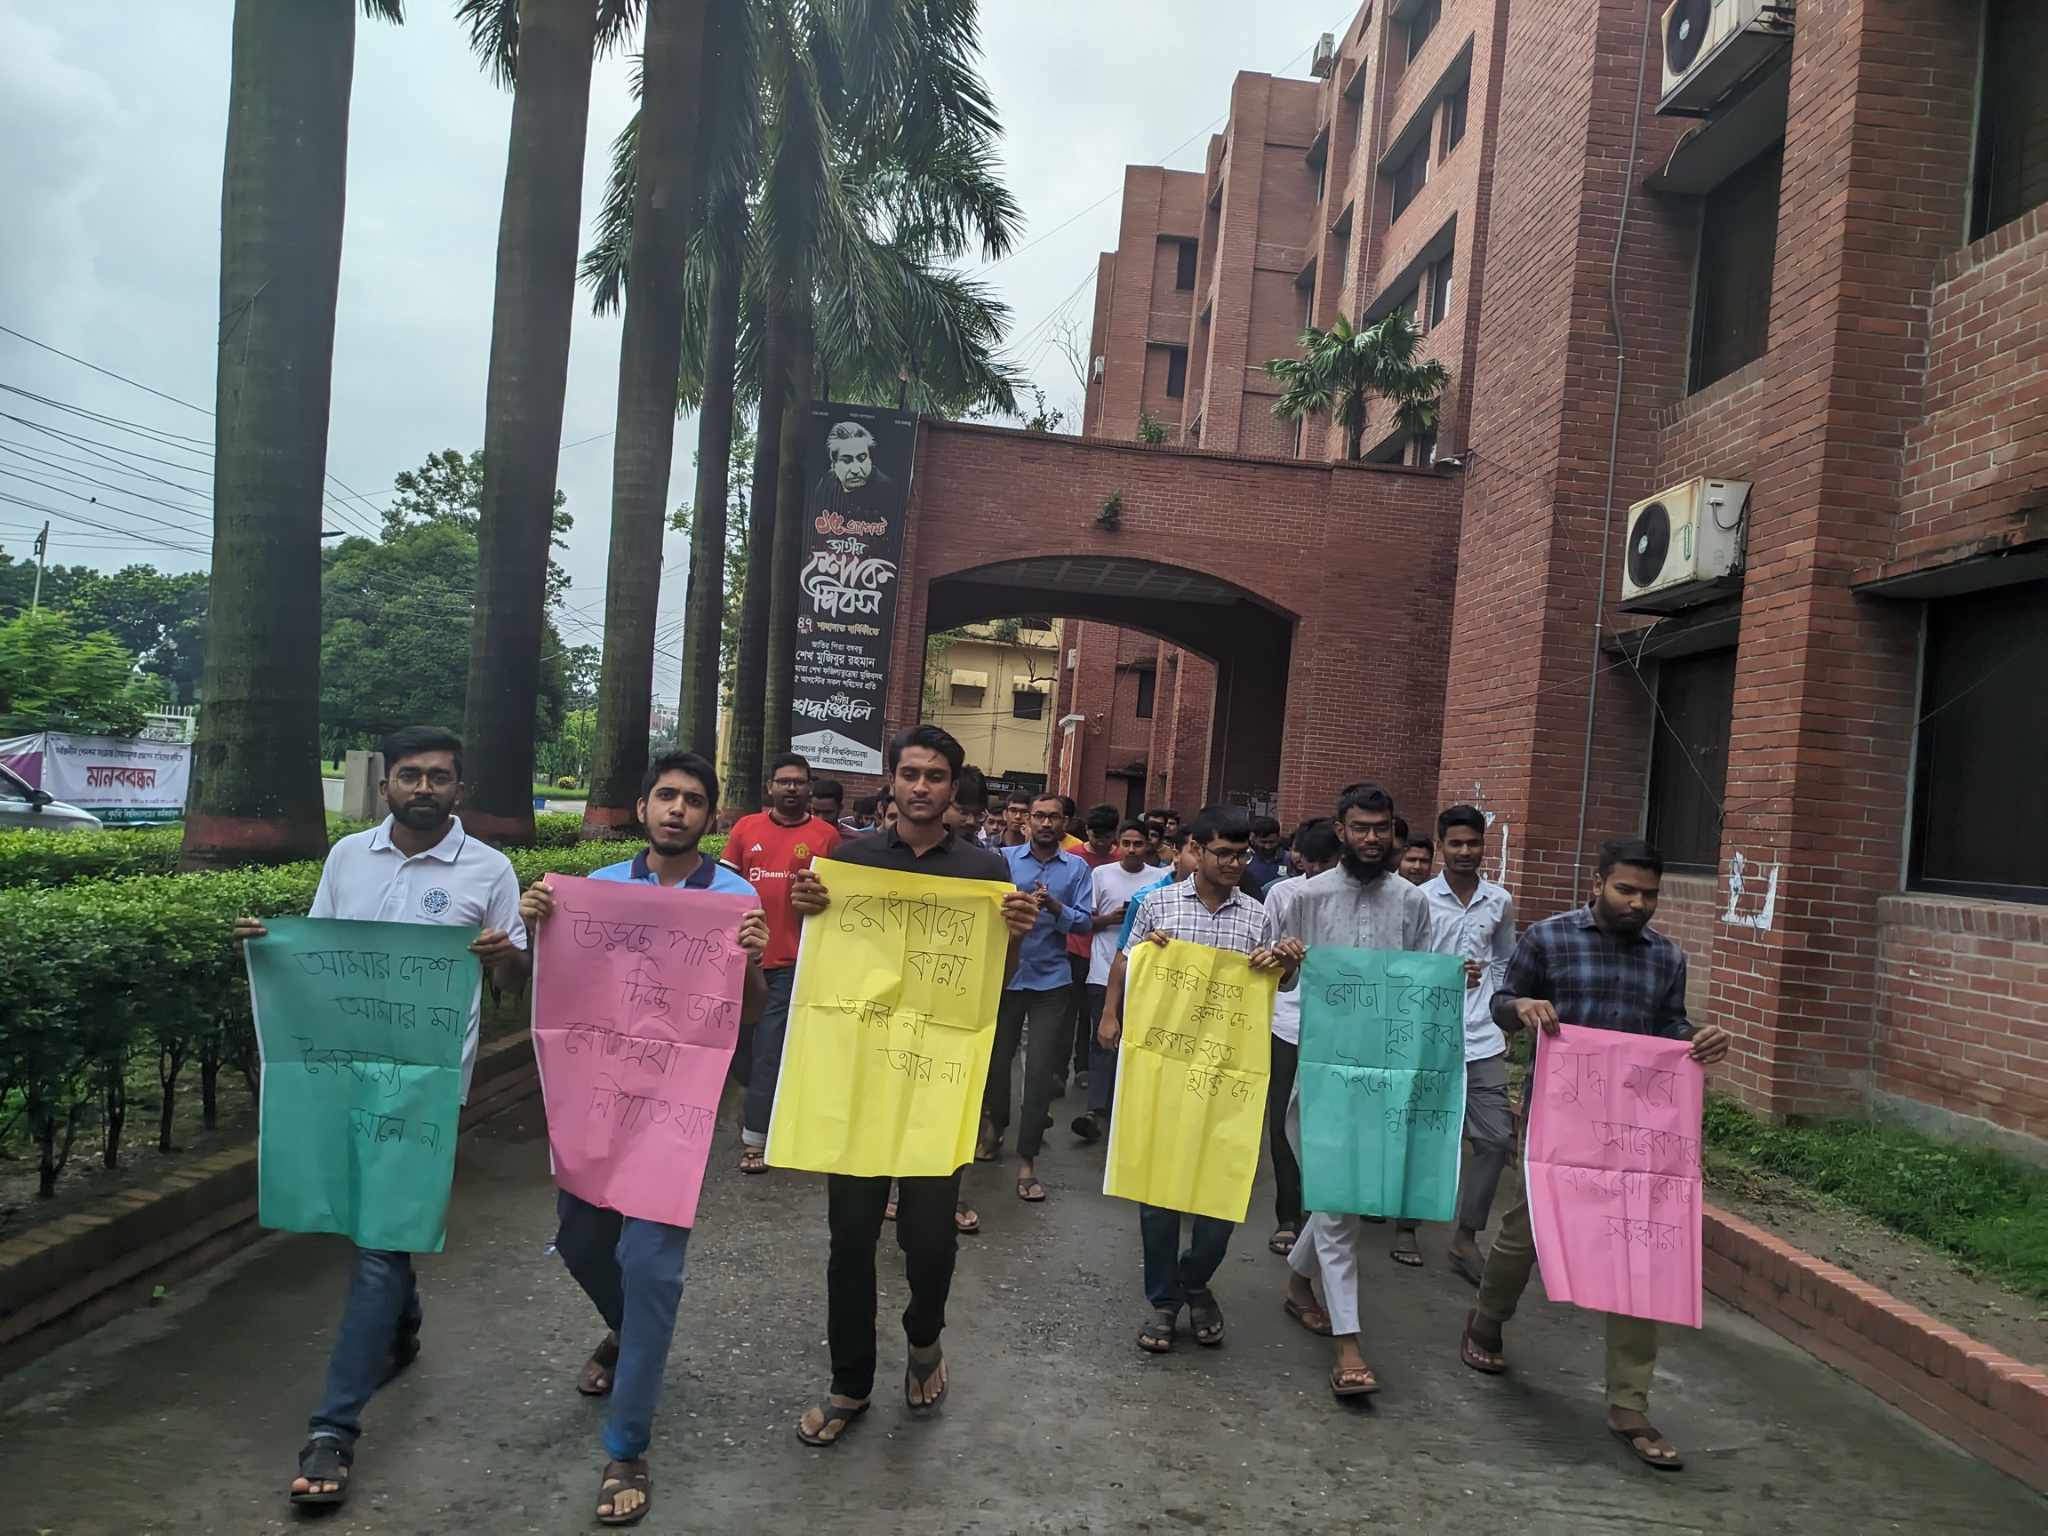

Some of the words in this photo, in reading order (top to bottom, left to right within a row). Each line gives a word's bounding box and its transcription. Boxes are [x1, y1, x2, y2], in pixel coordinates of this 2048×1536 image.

[800, 551, 897, 598] শোক
[808, 575, 882, 618] দিবস
[796, 650, 814, 661] শেখ
[816, 650, 845, 667] মুজিবুর
[847, 655, 876, 668] রহমান
[86, 765, 157, 790] মানববন্ধন
[563, 902, 661, 972] উড়ছে
[840, 891, 976, 947] মেধাবীদের
[290, 950, 390, 980] আমার
[399, 956, 463, 993] দেশ
[328, 997, 416, 1030] আমার
[836, 994, 893, 1031] আর
[903, 1010, 934, 1040] না
[875, 1048, 933, 1082] আর
[1144, 1026, 1197, 1056] বেকার
[1199, 1039, 1236, 1064] হতে
[1624, 1064, 1684, 1112] হবে
[350, 1107, 406, 1143] মানে
